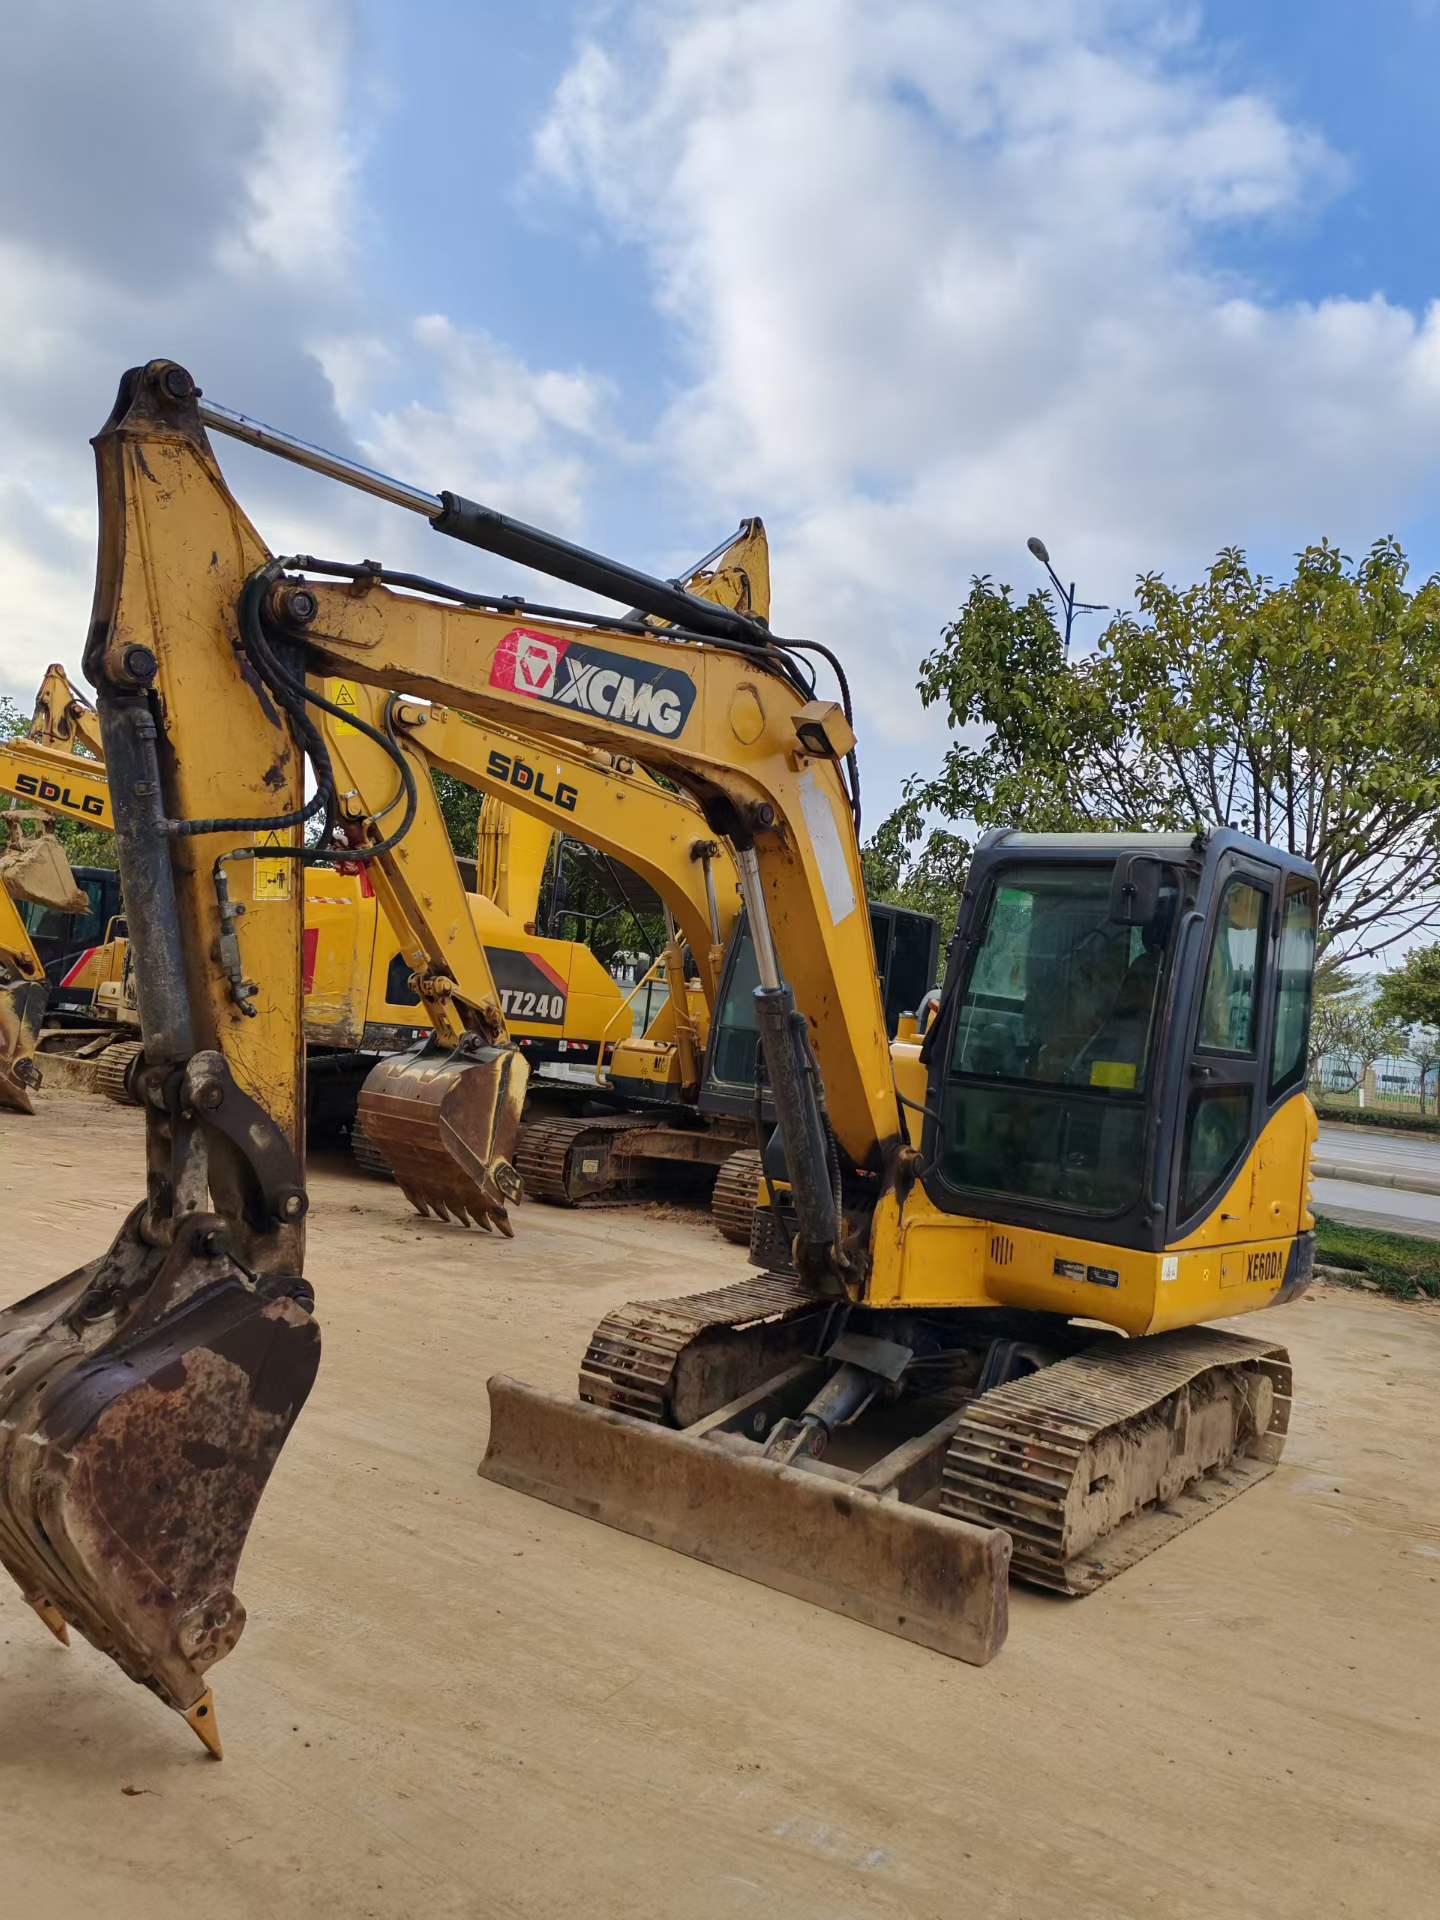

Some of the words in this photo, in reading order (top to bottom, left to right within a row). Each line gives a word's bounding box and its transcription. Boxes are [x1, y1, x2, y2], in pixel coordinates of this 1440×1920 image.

[553, 656, 682, 734] XCMG
[15, 773, 105, 816] SDLG
[486, 750, 578, 812] SDLG
[500, 989, 564, 1020] TZ240
[1246, 1251, 1283, 1281] XE60DA
